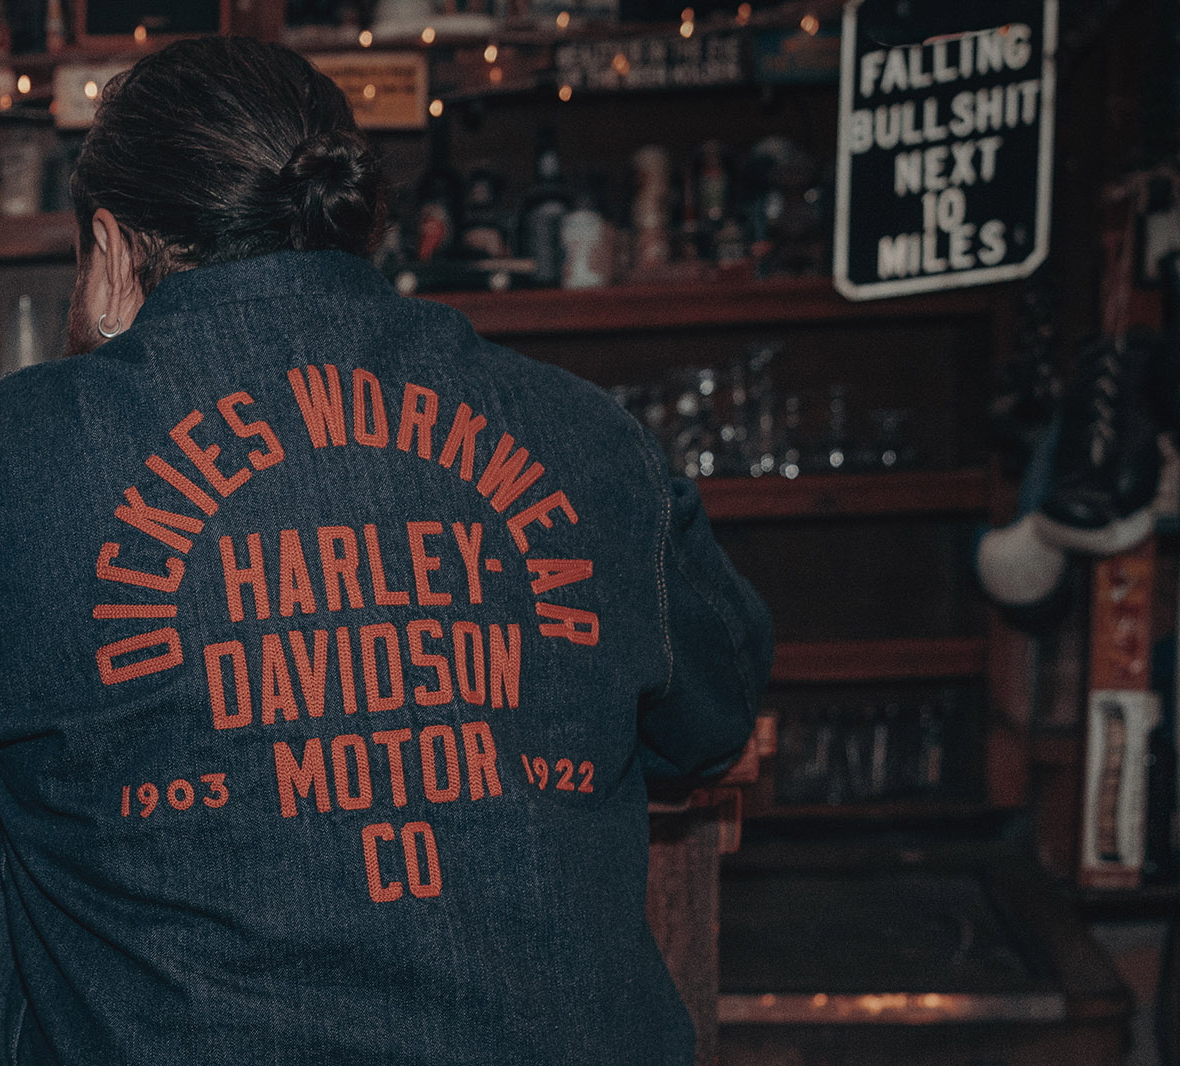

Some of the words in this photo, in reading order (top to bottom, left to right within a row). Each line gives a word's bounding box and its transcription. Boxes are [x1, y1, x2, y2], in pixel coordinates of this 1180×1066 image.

[859, 23, 1033, 98] FALLING
[851, 78, 1041, 155] BULLSHIT
[893, 135, 1004, 197] NEXT
[921, 186, 967, 233] 10
[876, 219, 1007, 280] MILES
[93, 391, 284, 685] DICKIES
[287, 364, 600, 646] WORKWEAR
[219, 520, 503, 623] HARLEY-
[204, 619, 521, 730] DAVIDSON
[121, 772, 230, 818] 1903
[273, 720, 502, 818] MOTOR
[521, 754, 595, 794] 1922
[362, 821, 443, 903] CO
